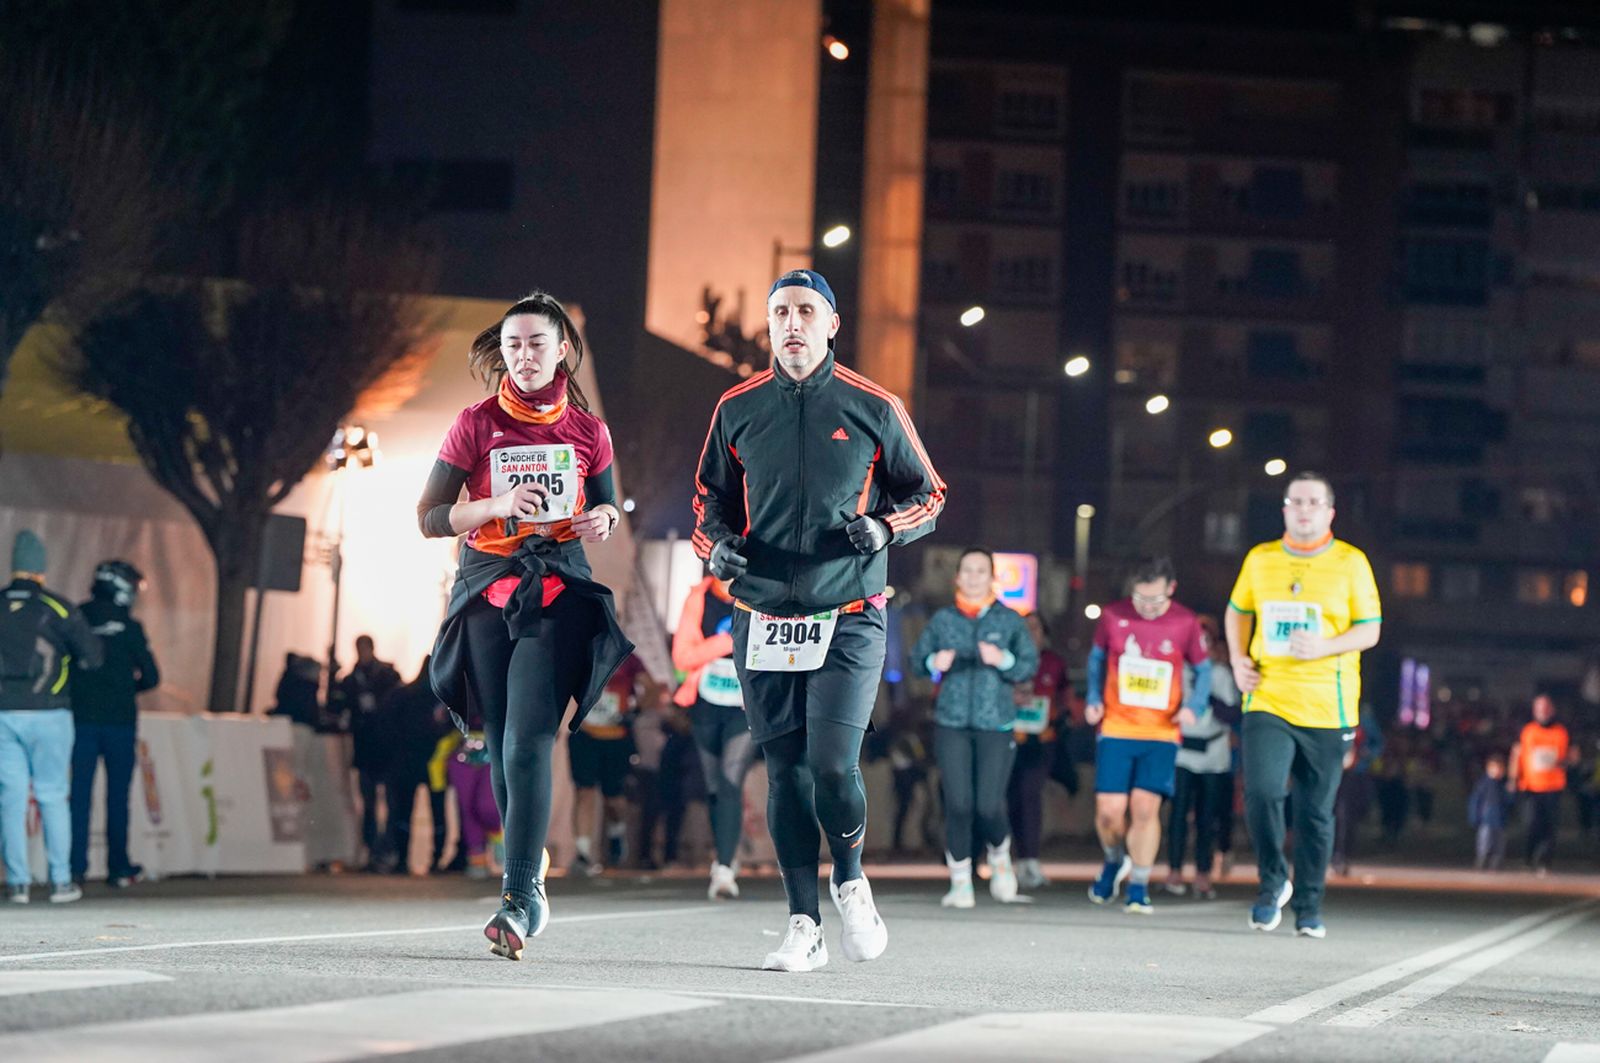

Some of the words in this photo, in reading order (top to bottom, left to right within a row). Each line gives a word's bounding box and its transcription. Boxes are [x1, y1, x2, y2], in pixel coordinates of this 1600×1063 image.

[510, 454, 536, 462] NOCHE
[537, 454, 547, 462] DE
[501, 464, 518, 473] SAN
[765, 622, 821, 645] 2904
